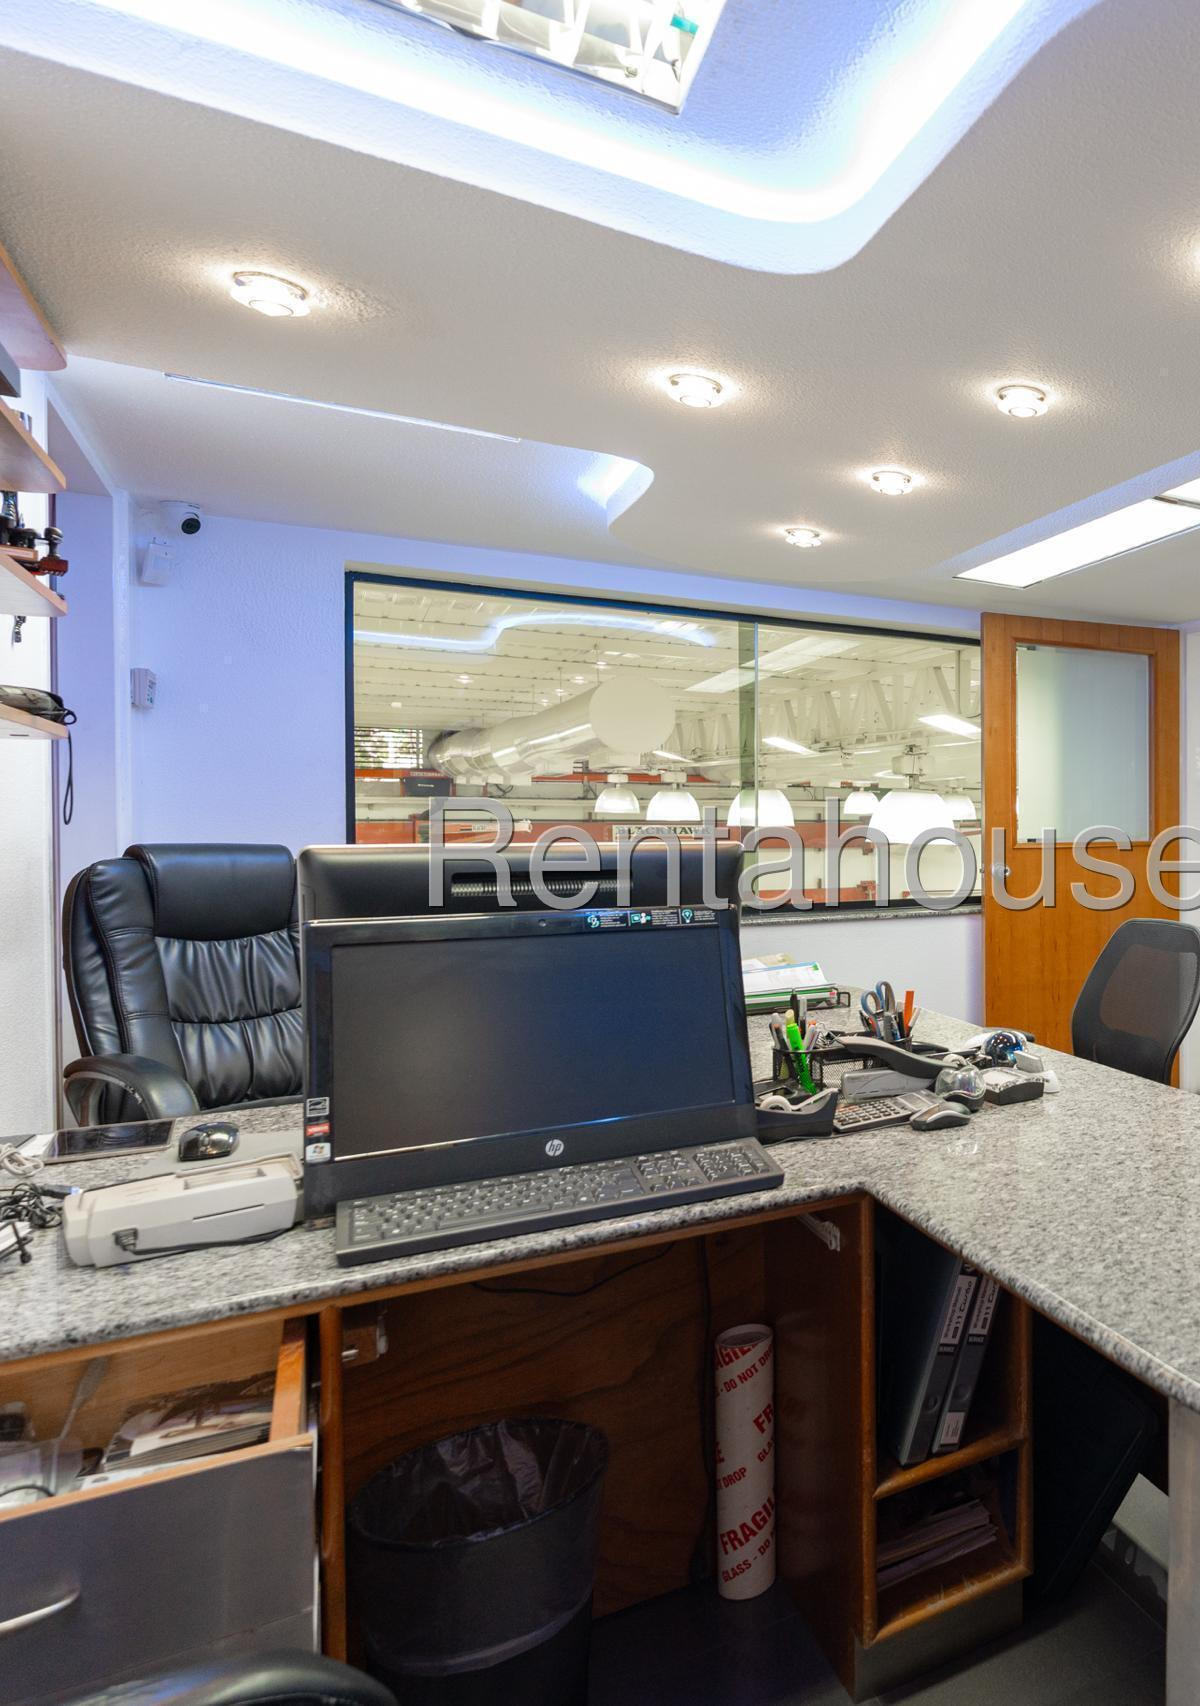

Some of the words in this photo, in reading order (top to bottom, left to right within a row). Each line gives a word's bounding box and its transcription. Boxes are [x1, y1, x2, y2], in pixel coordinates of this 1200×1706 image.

[724, 1379, 738, 1393] DO
[737, 1363, 759, 1384] NOT
[722, 1466, 748, 1488] DROP
[721, 1559, 752, 1583] GLASS
